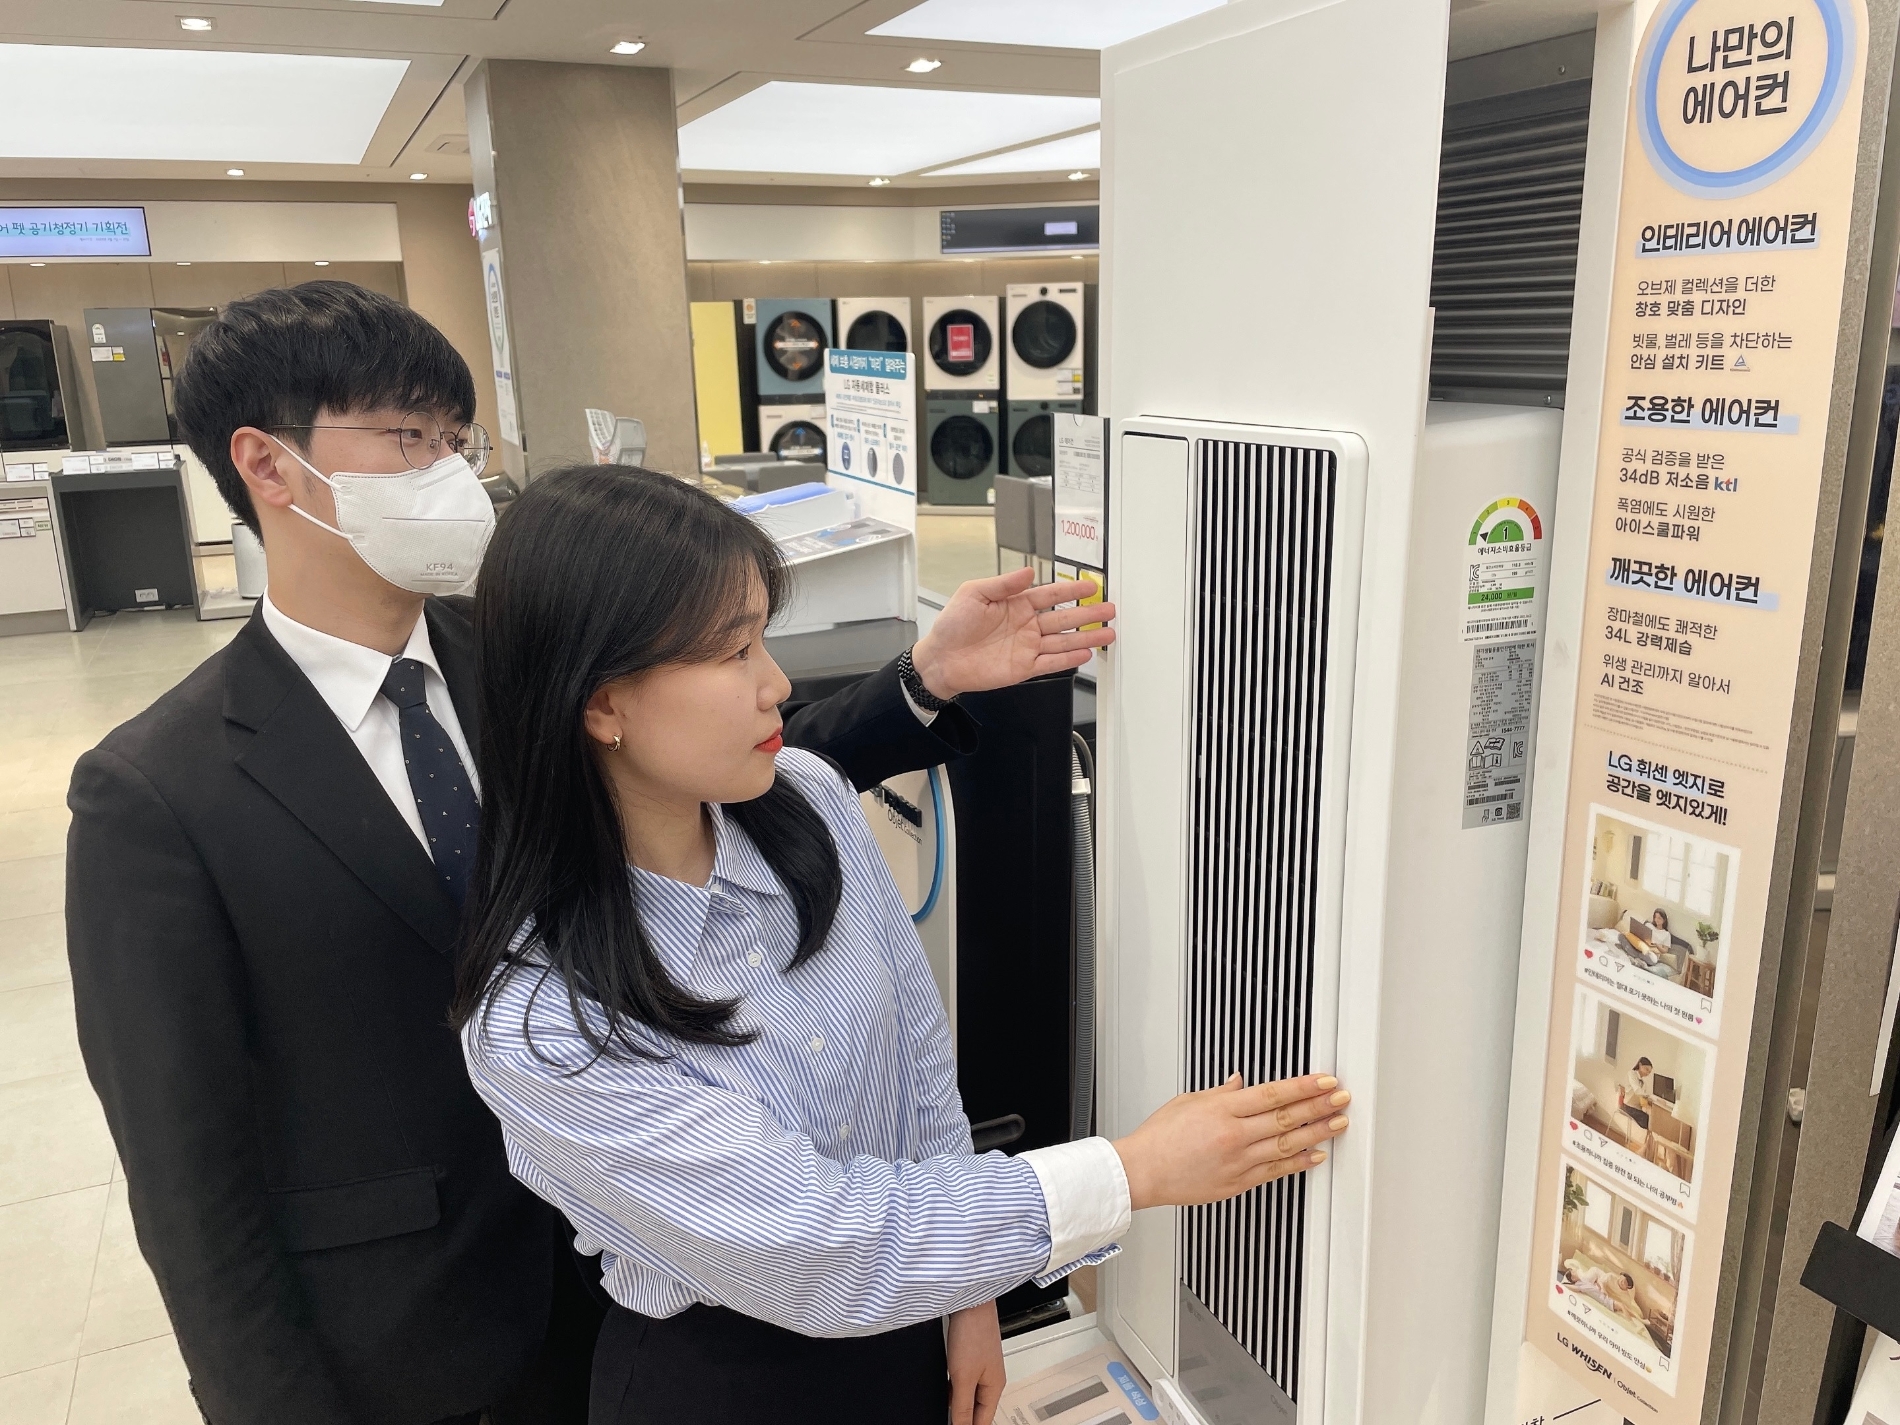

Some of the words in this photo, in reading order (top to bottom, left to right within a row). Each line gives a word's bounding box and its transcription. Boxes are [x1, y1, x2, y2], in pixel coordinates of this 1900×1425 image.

[1686, 16, 1795, 74] 나만의
[1682, 71, 1790, 125] 에어컨
[12, 222, 25, 236] 펫
[29, 222, 88, 236] 공기청정기
[92, 221, 129, 236] 기획전
[1640, 219, 1733, 253] 인테리어
[1737, 213, 1817, 246] 에어컨
[1636, 279, 1677, 296] 오브제
[1681, 276, 1739, 295] 컬렉션을
[1744, 275, 1776, 293] 더한
[1635, 300, 1662, 318] 창호
[1666, 300, 1695, 317] 맞춤
[1700, 298, 1747, 316] 디자인
[1632, 333, 1662, 350] 빗물,
[1664, 333, 1691, 349] 벌레
[1695, 332, 1725, 349] 등을
[1729, 332, 1793, 349] 차단하는
[1630, 354, 1656, 371] 안심
[1661, 353, 1689, 370] 설치
[1695, 353, 1725, 370] 키트
[1624, 395, 1694, 424] 조용한
[1701, 397, 1779, 428] 에어컨
[1621, 448, 1647, 464] 공식
[1651, 450, 1691, 467] 검증을
[1696, 452, 1725, 470] 받은
[1619, 467, 1660, 485] 34dB
[1665, 471, 1709, 490] 저소음
[1714, 476, 1738, 493] ktl
[1617, 497, 1668, 517] 폭염에도
[1672, 503, 1716, 523] 시원한
[1061, 519, 1095, 541] 1,200,000
[1503, 526, 1510, 541] 1
[1615, 517, 1700, 542] 아이스쿨파워
[1477, 543, 1532, 555] 에너지소비효율등급
[426, 563, 453, 572] KF94
[1610, 557, 1677, 591] 깨끗한
[1683, 568, 1760, 604] 에어컨
[1481, 592, 1502, 602] 24,000
[1607, 606, 1670, 632] 장마철에도
[1674, 619, 1718, 640] 쾌적한
[1605, 625, 1632, 644] 34L
[1637, 631, 1692, 656] 강력제습
[1601, 673, 1615, 687] AI
[1618, 676, 1644, 695] 건조
[1603, 654, 1627, 671] 위생
[1631, 659, 1683, 684] 관리까지
[1688, 672, 1731, 695] 알아서
[1608, 750, 1632, 773] LG
[1636, 758, 1668, 784] 휘센
[1673, 768, 1725, 799] 엣지로
[1606, 774, 1651, 803] 공간을
[1656, 789, 1728, 826] 엣지있게!
[1660, 1002, 1673, 1014] 나의
[1646, 1182, 1658, 1196] 나의
[1557, 1332, 1569, 1348] LG
[1571, 1342, 1613, 1380] WHISEN
[1617, 1380, 1637, 1399] Objet
